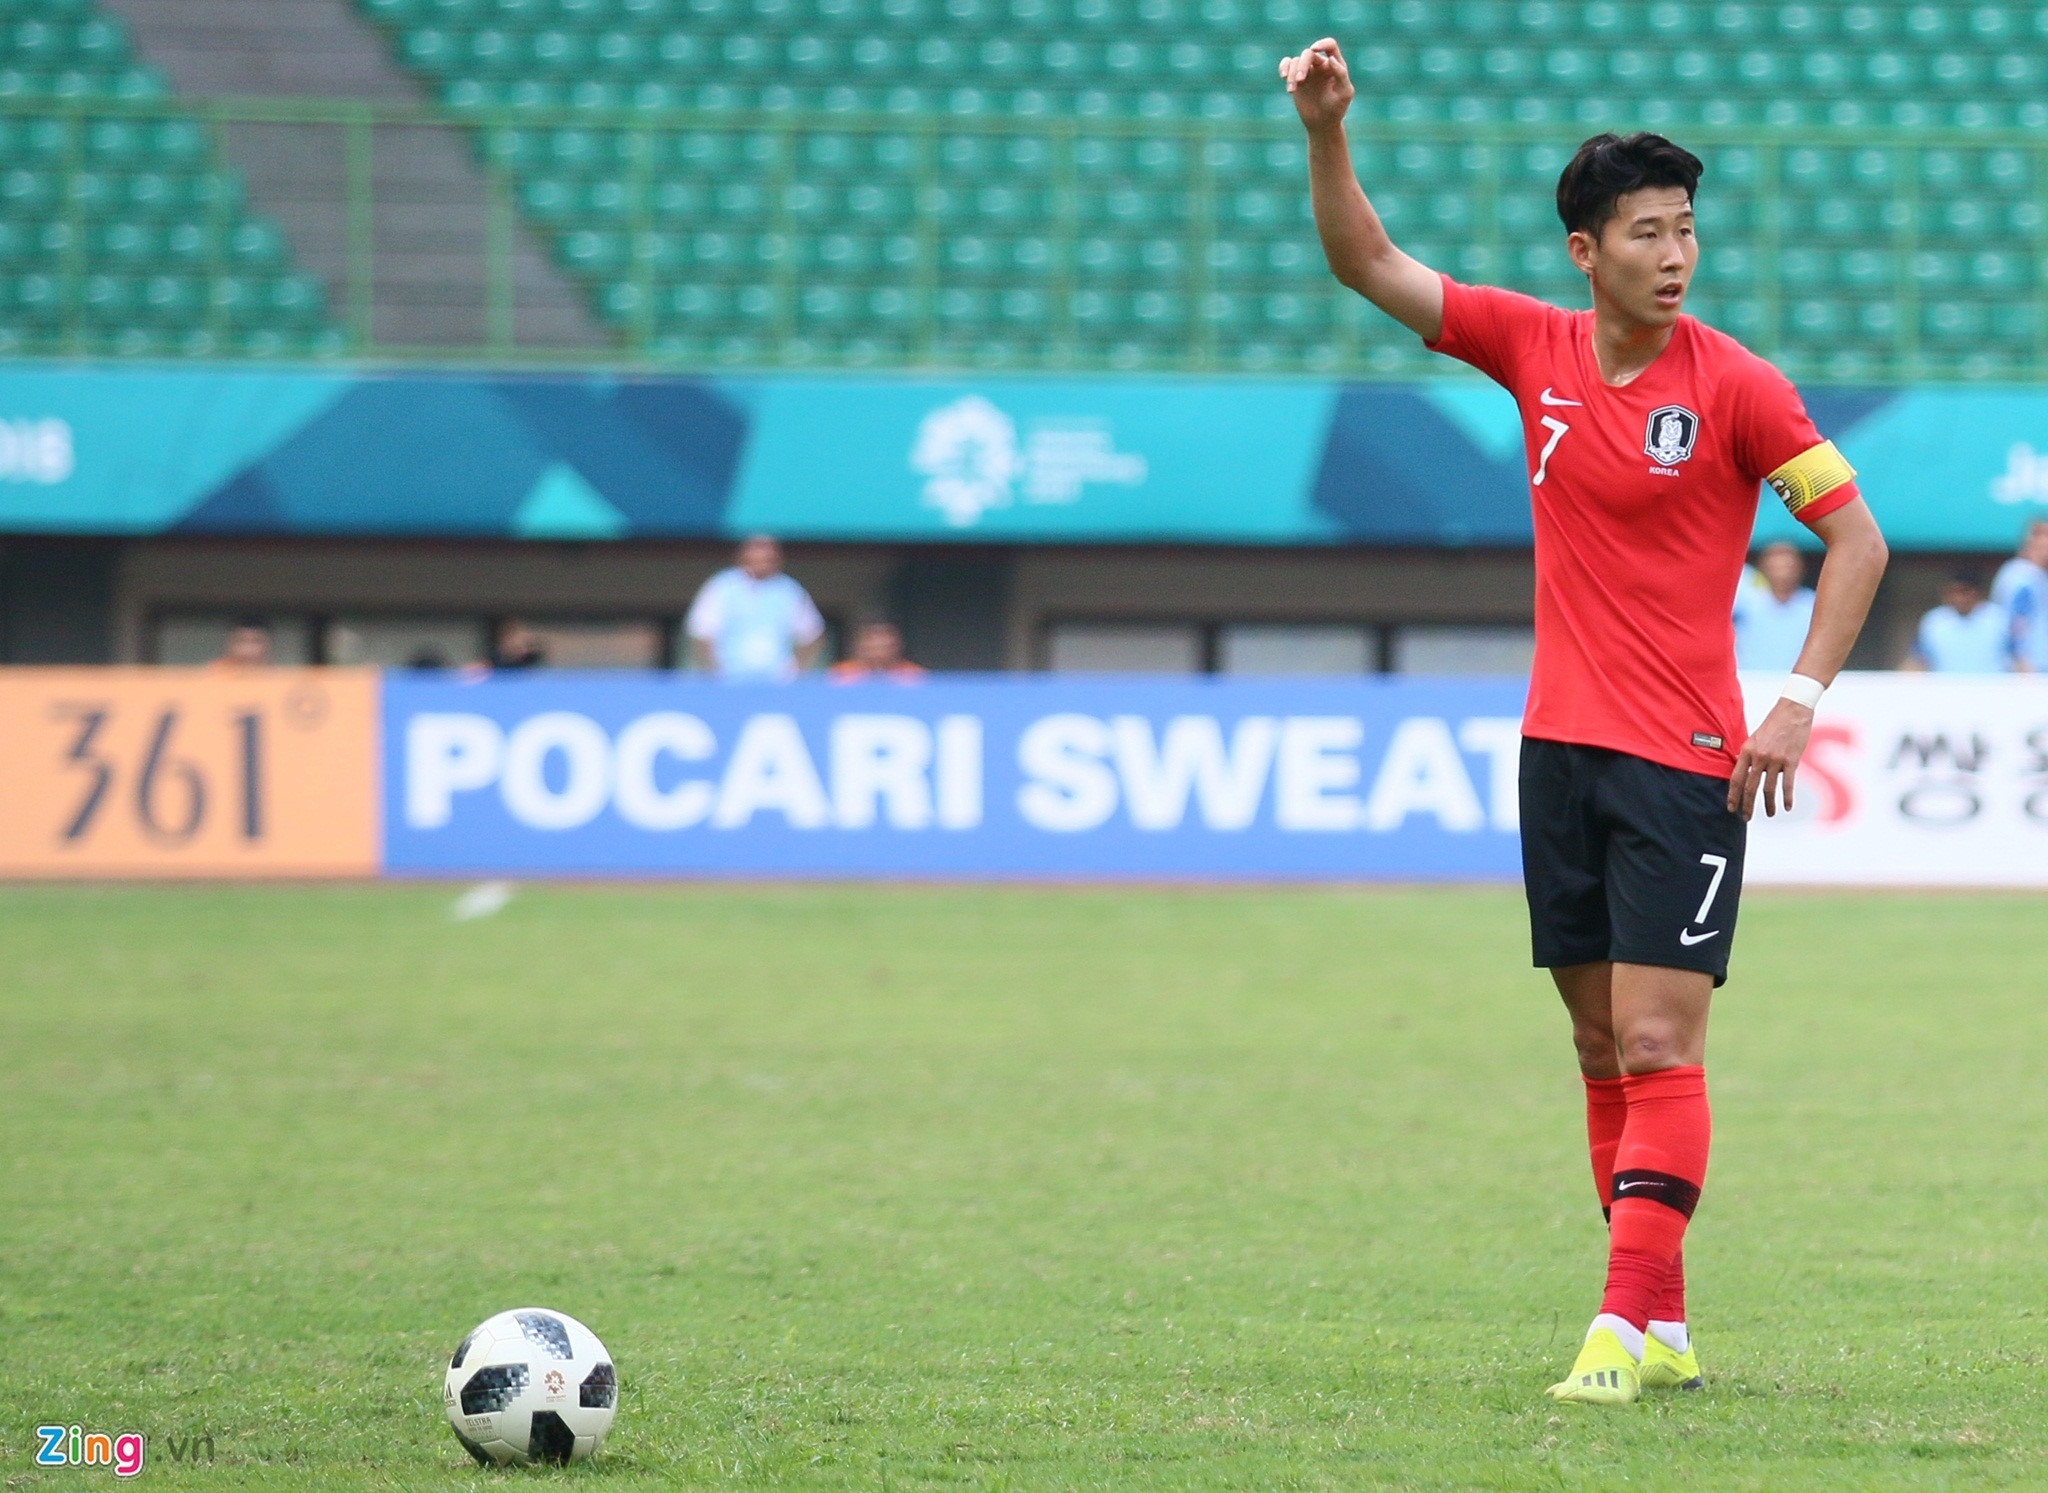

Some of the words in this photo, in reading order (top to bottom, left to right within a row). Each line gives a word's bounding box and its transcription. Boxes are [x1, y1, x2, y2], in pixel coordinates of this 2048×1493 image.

[1532, 415, 1569, 486] 7
[1649, 466, 1680, 477] KOREA
[406, 711, 983, 831] POCARI
[1017, 712, 1521, 834] SWEAT
[1694, 853, 1727, 924] 7
[465, 1416, 492, 1427] TELSTRA
